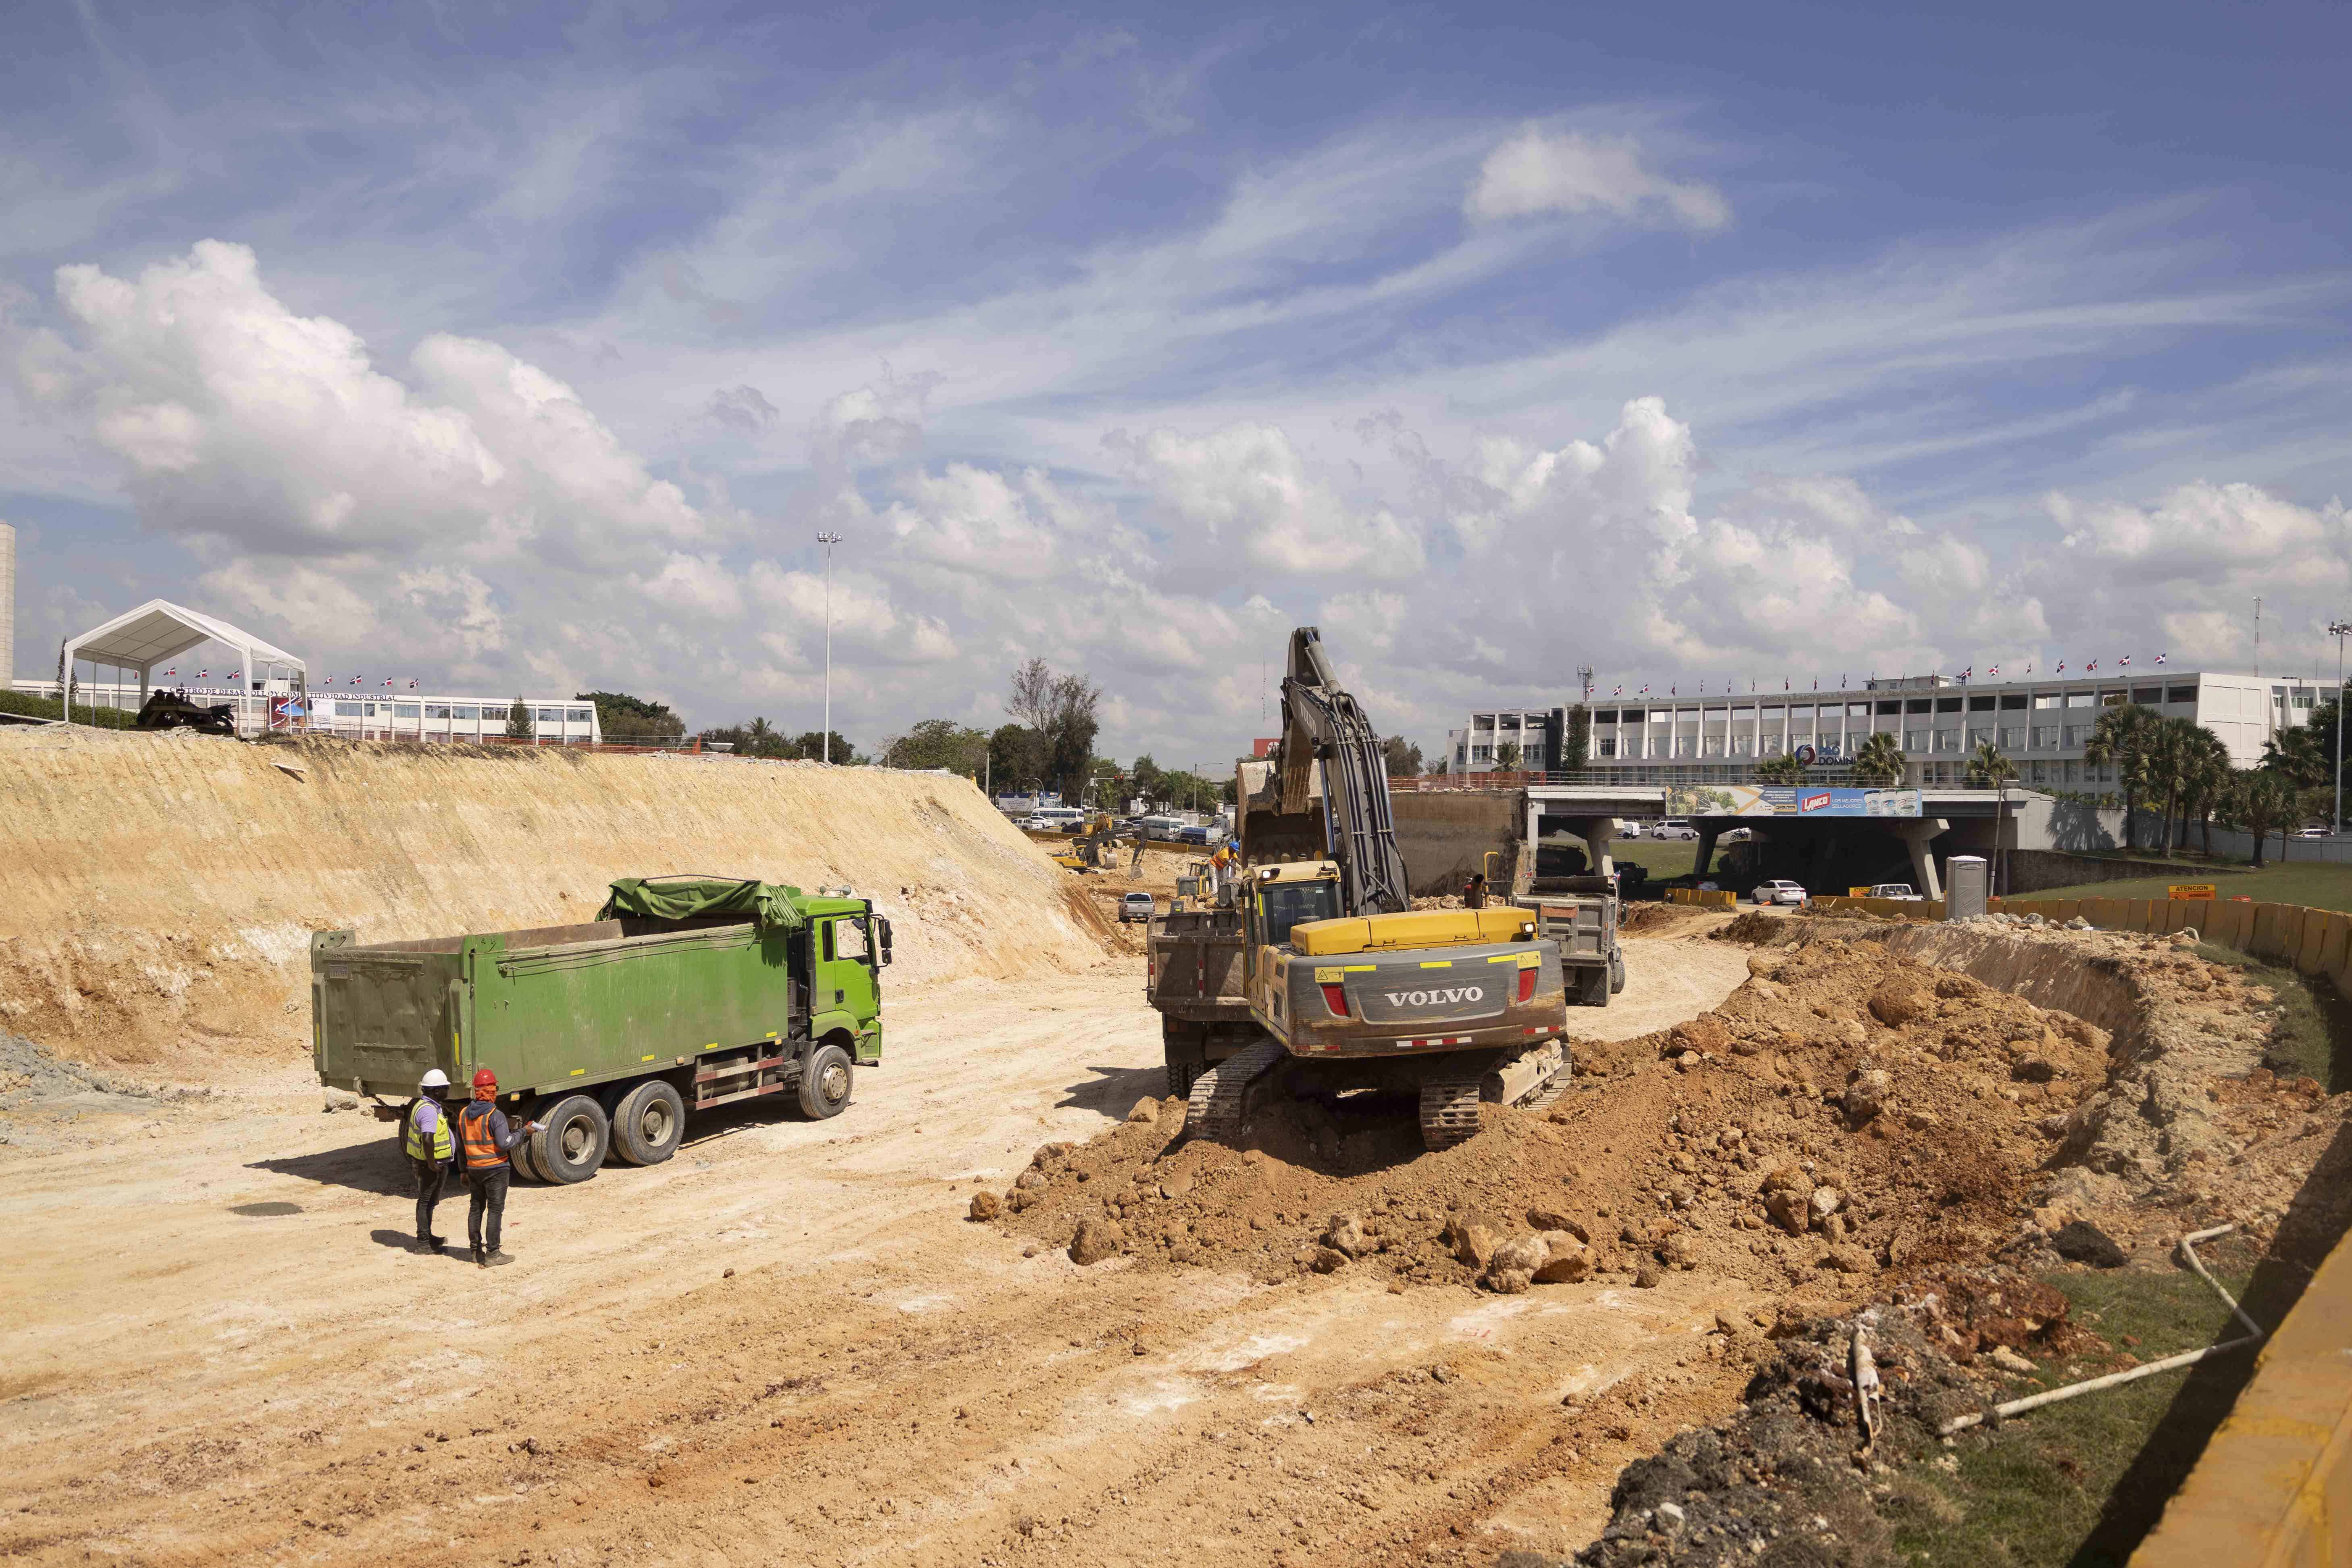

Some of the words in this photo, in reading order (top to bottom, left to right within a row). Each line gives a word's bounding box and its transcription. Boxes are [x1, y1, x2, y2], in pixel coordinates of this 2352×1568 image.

[281, 691, 349, 699] COMTITIVIDAD
[1300, 701, 1316, 735] VOLVO
[1819, 745, 1840, 755] PRO
[1804, 796, 1828, 811] LANCO
[1384, 986, 1483, 1007] VOLVO
